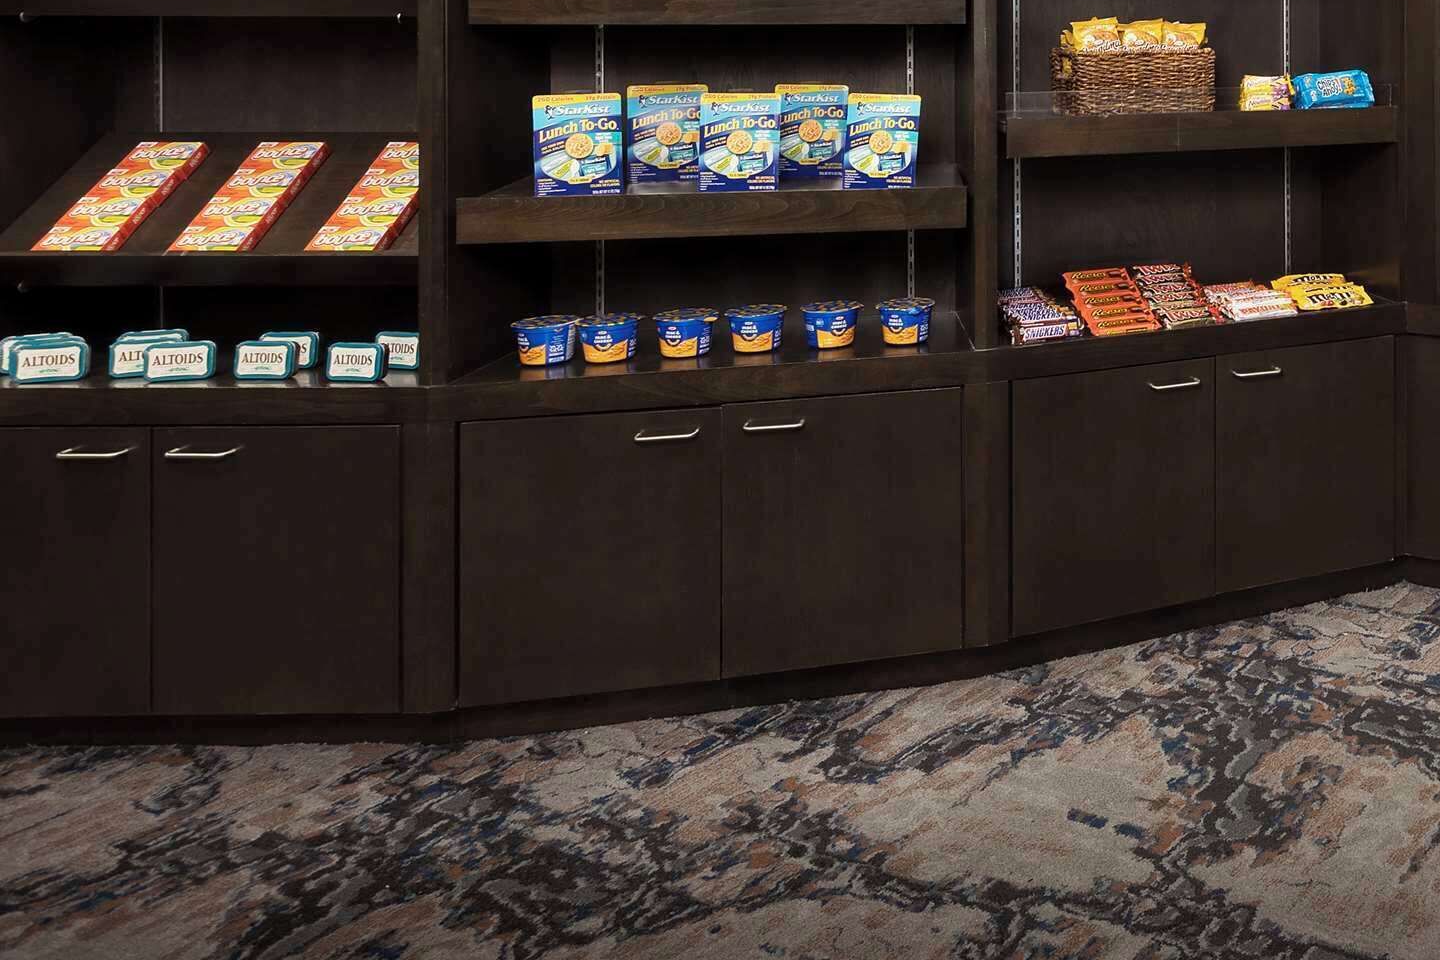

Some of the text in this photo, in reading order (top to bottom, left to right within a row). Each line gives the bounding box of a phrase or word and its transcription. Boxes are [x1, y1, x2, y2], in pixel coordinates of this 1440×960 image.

[1317, 78, 1337, 90] Chips
[648, 94, 698, 105] StarKist
[793, 93, 840, 103] StarKist
[557, 104, 612, 117] StarKist
[720, 102, 771, 113] StarKist
[865, 102, 913, 114] StarKist
[632, 111, 669, 130] Lunch
[780, 106, 811, 126] Lunch
[538, 120, 578, 144] Lunch
[703, 117, 740, 139] Lunch
[849, 117, 882, 137] Lunch
[1025, 325, 1064, 339] SNICKERS
[22, 353, 76, 368] ALTOIDS
[152, 353, 204, 366] ALTOIDS
[241, 352, 283, 365] ALTOIDS
[333, 354, 373, 366] ALTOIDS
